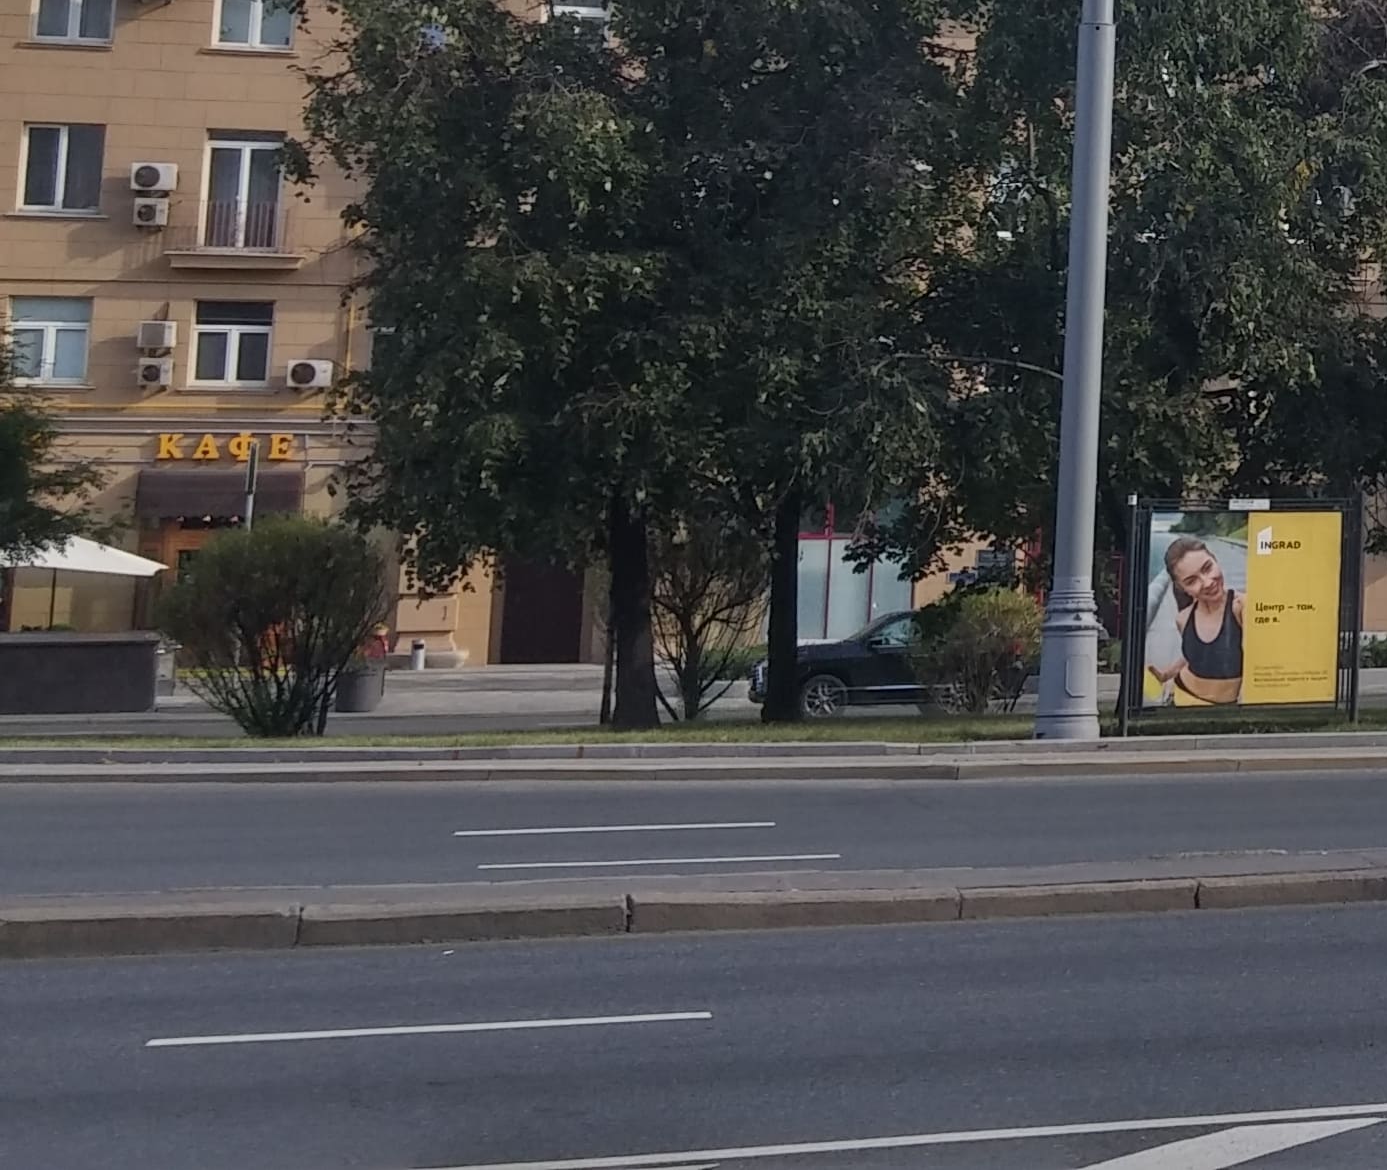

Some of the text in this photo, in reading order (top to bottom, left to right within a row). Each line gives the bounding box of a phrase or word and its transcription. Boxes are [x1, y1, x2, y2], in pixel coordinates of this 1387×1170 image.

[156, 432, 295, 462] КАФЕ
[1260, 540, 1302, 550] INGRAD
[1255, 602, 1285, 613] Центр
